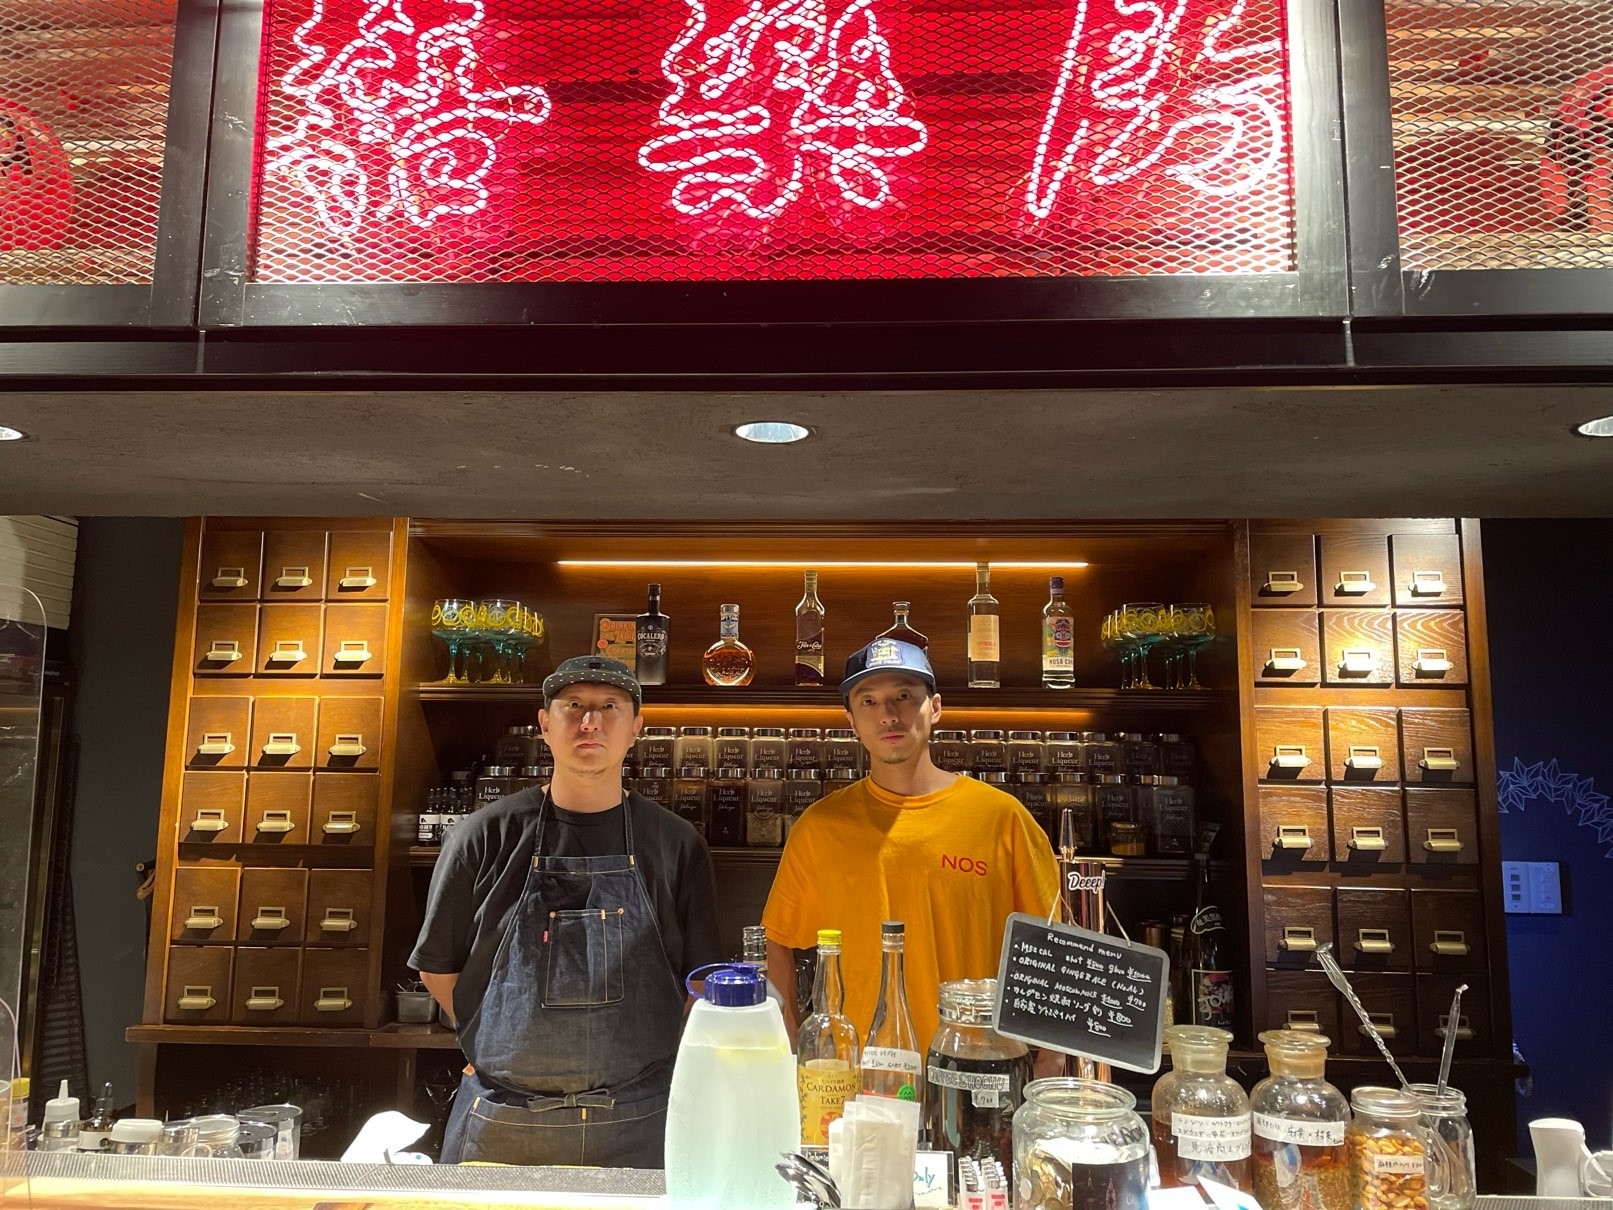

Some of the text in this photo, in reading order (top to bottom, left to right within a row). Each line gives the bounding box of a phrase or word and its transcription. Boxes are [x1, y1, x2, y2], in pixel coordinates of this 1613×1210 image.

[637, 632, 665, 640] COCALERO
[644, 752, 668, 760] Liqueur
[681, 752, 706, 760] Liqueur
[754, 754, 779, 762] Liqueur
[676, 794, 701, 802] Liqueur
[714, 794, 739, 802] Liqueur
[942, 854, 988, 877] NOS
[1068, 870, 1105, 894] Deeep!
[1047, 933, 1122, 960] Recommend menu
[1018, 956, 1056, 972] ORIGINAL
[1013, 973, 1049, 988] ORIGINAL
[959, 1073, 1006, 1090] SHOCHU
[806, 1082, 856, 1092] CARDAMON
